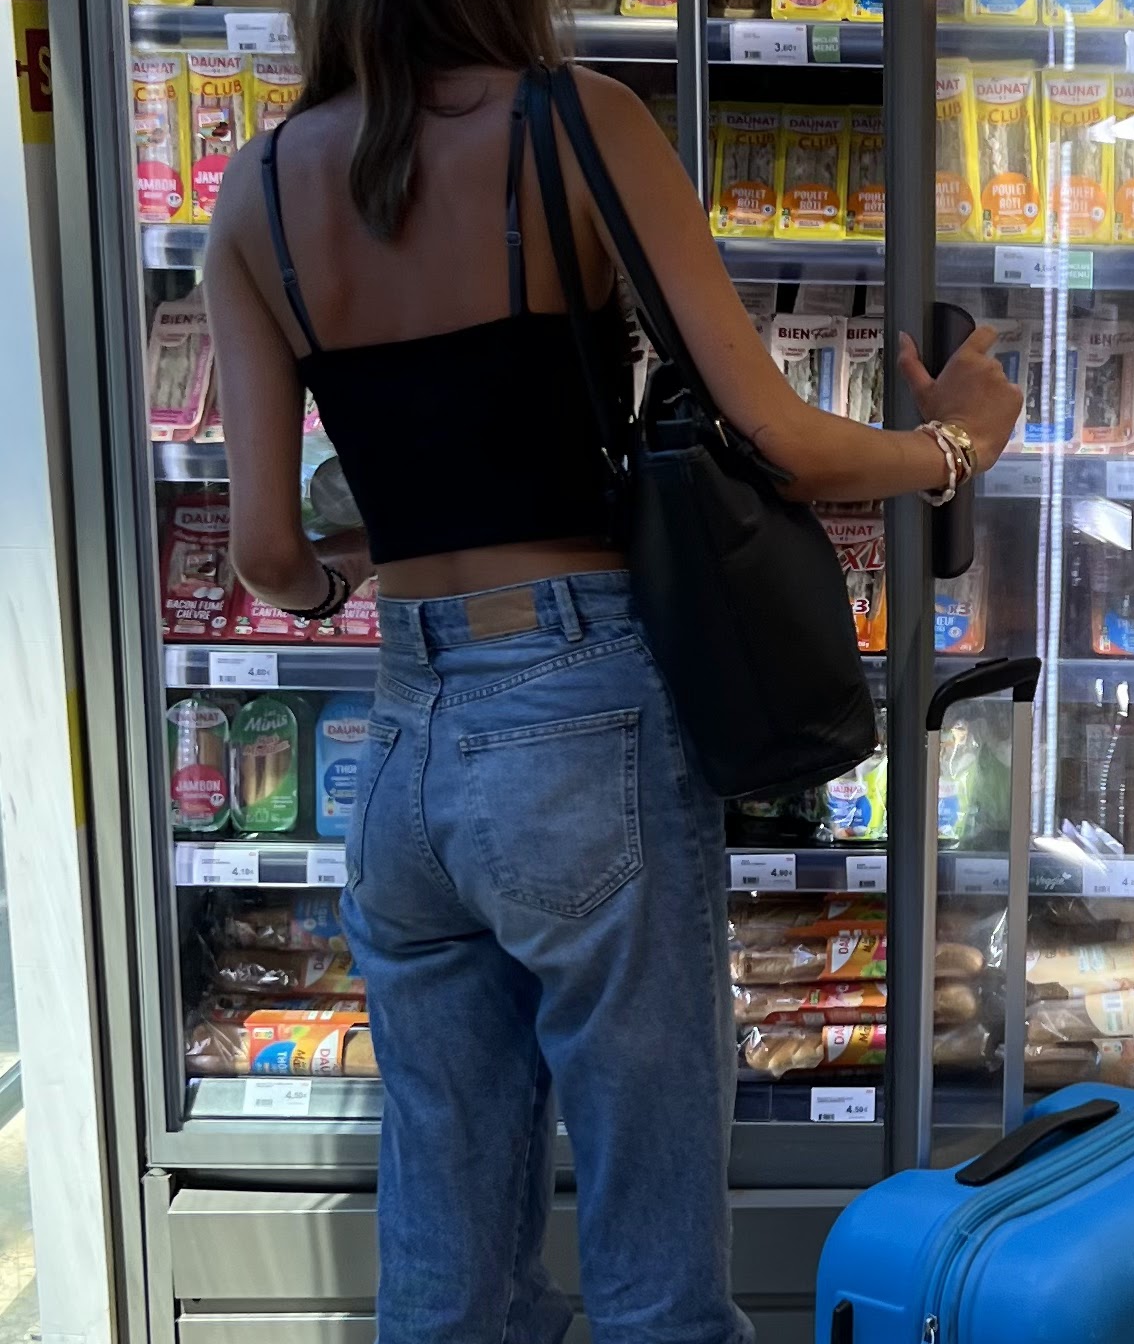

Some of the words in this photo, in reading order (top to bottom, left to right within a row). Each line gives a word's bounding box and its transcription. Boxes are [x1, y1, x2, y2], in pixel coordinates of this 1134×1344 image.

[813, 43, 840, 53] MENU
[133, 62, 176, 74] AUNAT
[191, 56, 241, 69] DAUNAT
[257, 63, 303, 75] DAUNA
[202, 80, 242, 97] CLUB
[976, 82, 1028, 96] DAUNAT
[1050, 84, 1101, 97] DAUNAT
[268, 88, 302, 104] CLU
[988, 104, 1028, 124] CLUB
[1060, 106, 1101, 124] CLUB
[726, 115, 777, 127] DAUNAT
[789, 118, 840, 130] DAUNAT
[852, 118, 884, 129] DAUN
[735, 132, 775, 147] CLUB
[799, 135, 838, 150] CLUB
[195, 170, 224, 185] JAM
[137, 178, 177, 192] AMBON
[992, 182, 1026, 195] POULET
[732, 189, 766, 200] POULET
[794, 190, 828, 201] POULET
[161, 313, 191, 324] BIEN
[779, 328, 809, 340] BIEN
[847, 328, 877, 340] BIEN
[182, 511, 230, 524] DAUNA
[826, 525, 874, 537] AUNAT
[244, 714, 288, 732] Minis
[328, 724, 366, 736] DAUNA
